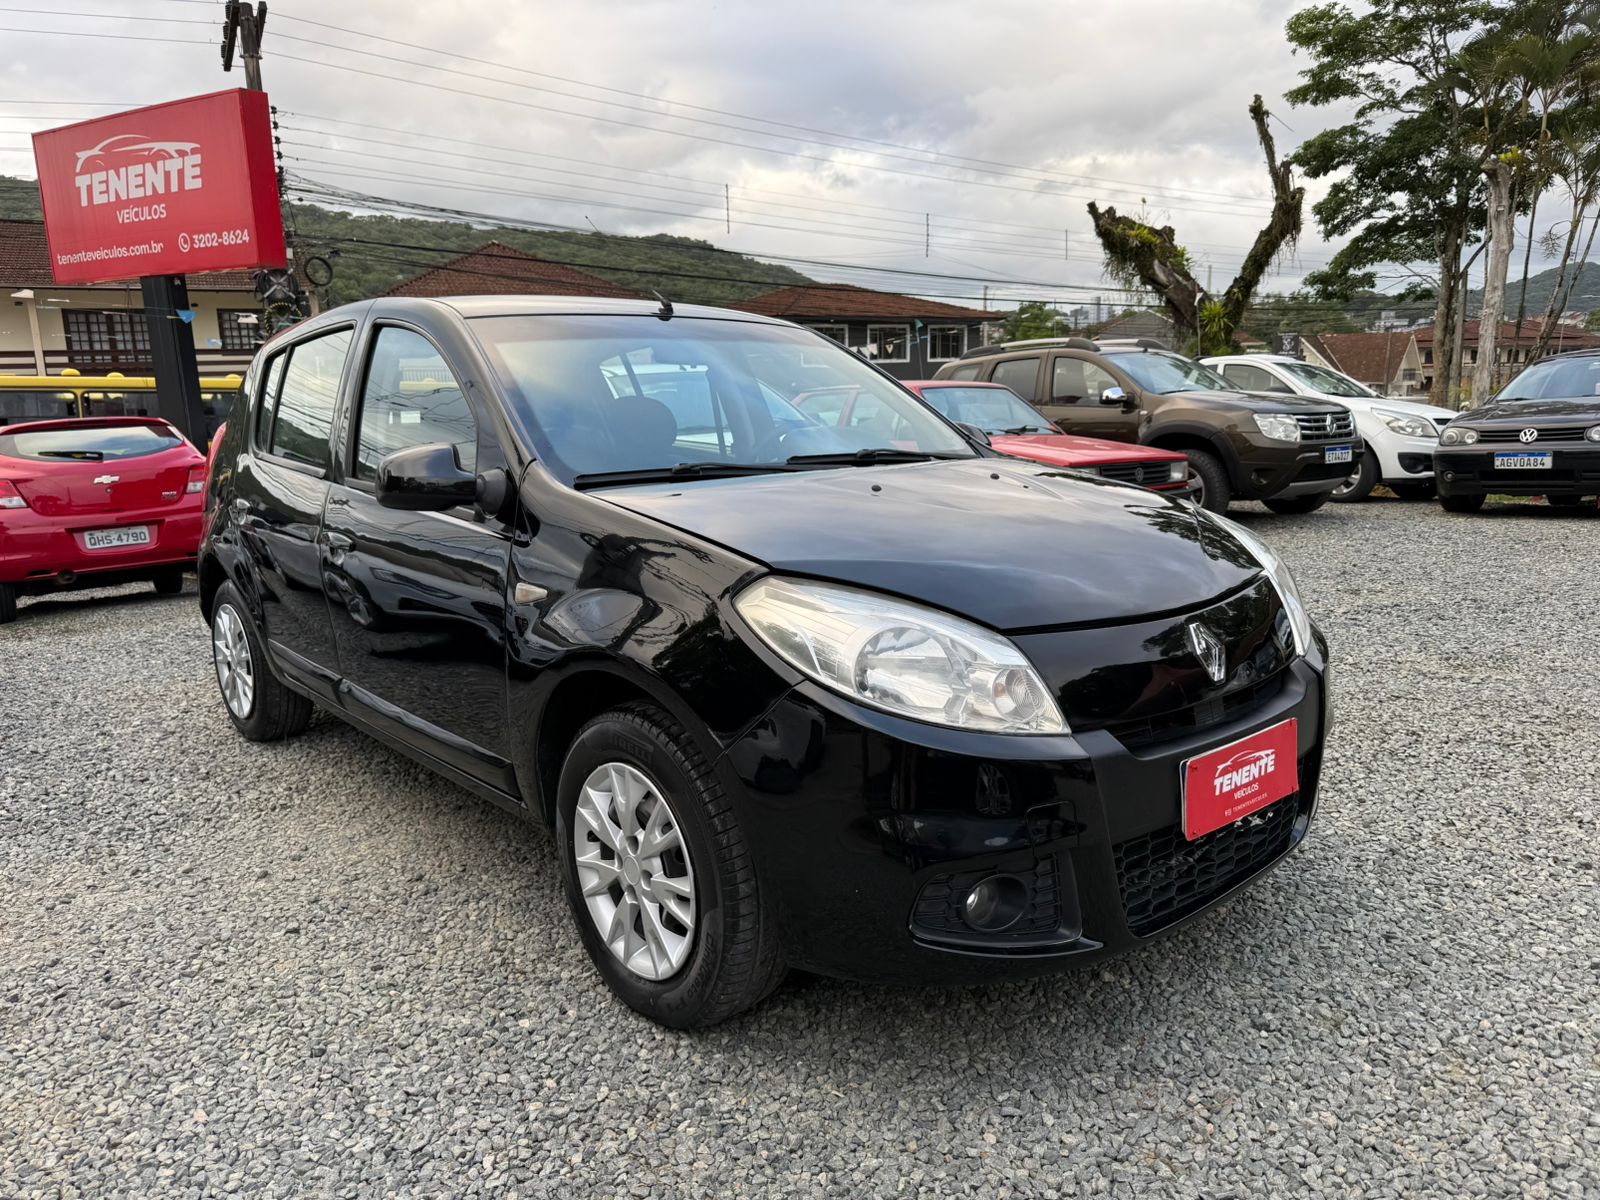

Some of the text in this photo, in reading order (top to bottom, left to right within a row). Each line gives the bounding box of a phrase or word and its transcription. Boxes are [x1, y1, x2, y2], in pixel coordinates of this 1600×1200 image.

[75, 153, 202, 207] TENENTE
[116, 203, 167, 225] VEÍCULOS
[192, 228, 250, 249] 3202-8624
[57, 241, 164, 266] tenenteveiculos.com.br
[1213, 754, 1275, 796] TENENTE
